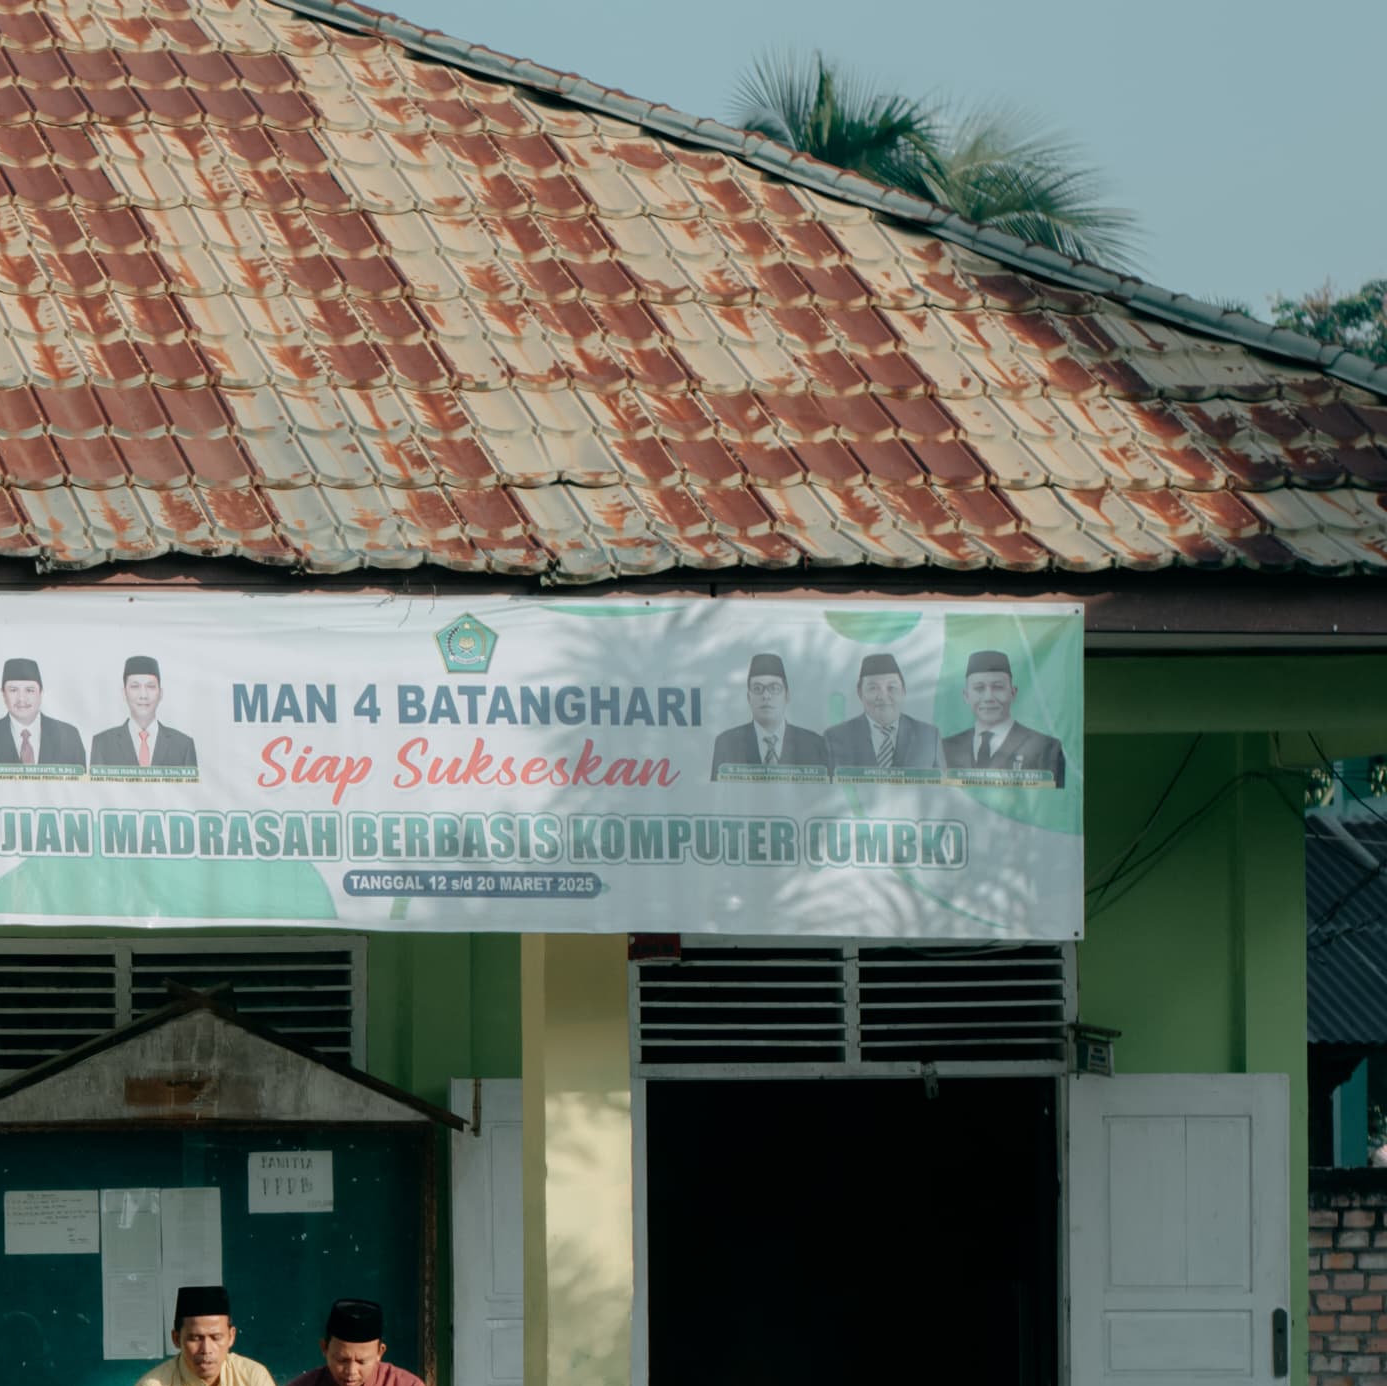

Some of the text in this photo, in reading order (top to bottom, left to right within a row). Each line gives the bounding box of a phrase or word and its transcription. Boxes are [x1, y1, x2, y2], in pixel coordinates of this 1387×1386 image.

[232, 684, 702, 727] MAN 4 BATANGHARI
[257, 735, 681, 805] Siap Sukseskan
[101, 812, 339, 857] MADRASAH
[349, 814, 559, 861] BERBASIS
[570, 817, 797, 863] KOMPUTER
[808, 820, 966, 867] (UMBK)
[350, 875, 594, 892] TANGGAL 12 s/d 20 MARET 2025
